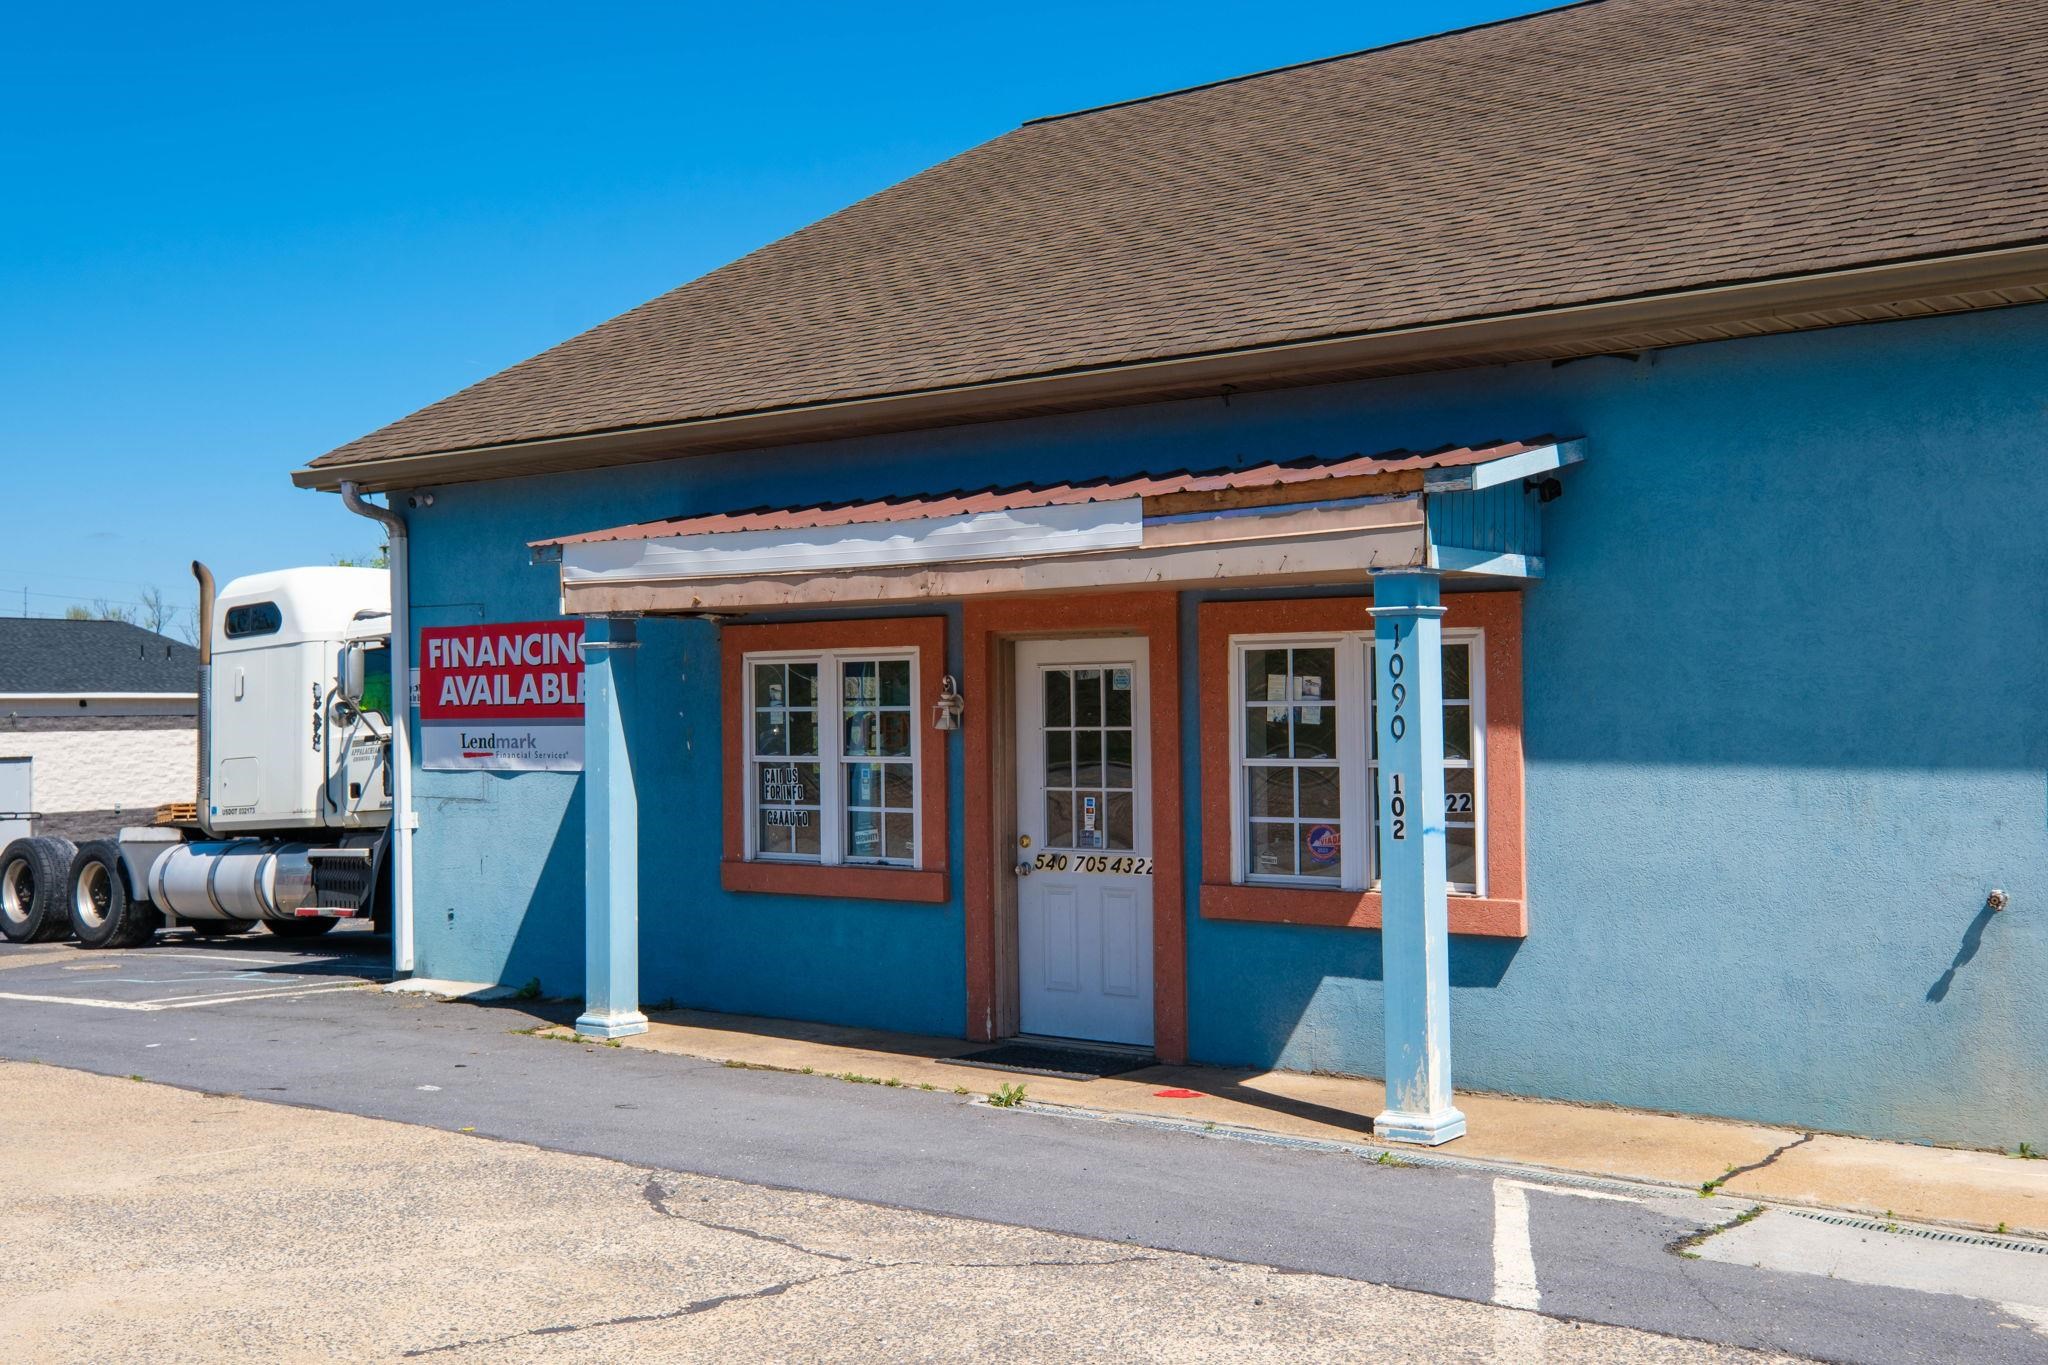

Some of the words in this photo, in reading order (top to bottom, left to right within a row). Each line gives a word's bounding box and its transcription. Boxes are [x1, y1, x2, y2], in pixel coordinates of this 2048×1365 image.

[461, 733, 537, 749] Lendmark
[496, 751, 531, 759] Financial
[786, 769, 798, 783] US
[765, 784, 781, 799] FOR
[783, 785, 803, 800] INFO
[1391, 774, 1405, 840] 102
[1034, 854, 1067, 871] 540
[1074, 855, 1108, 873] 705
